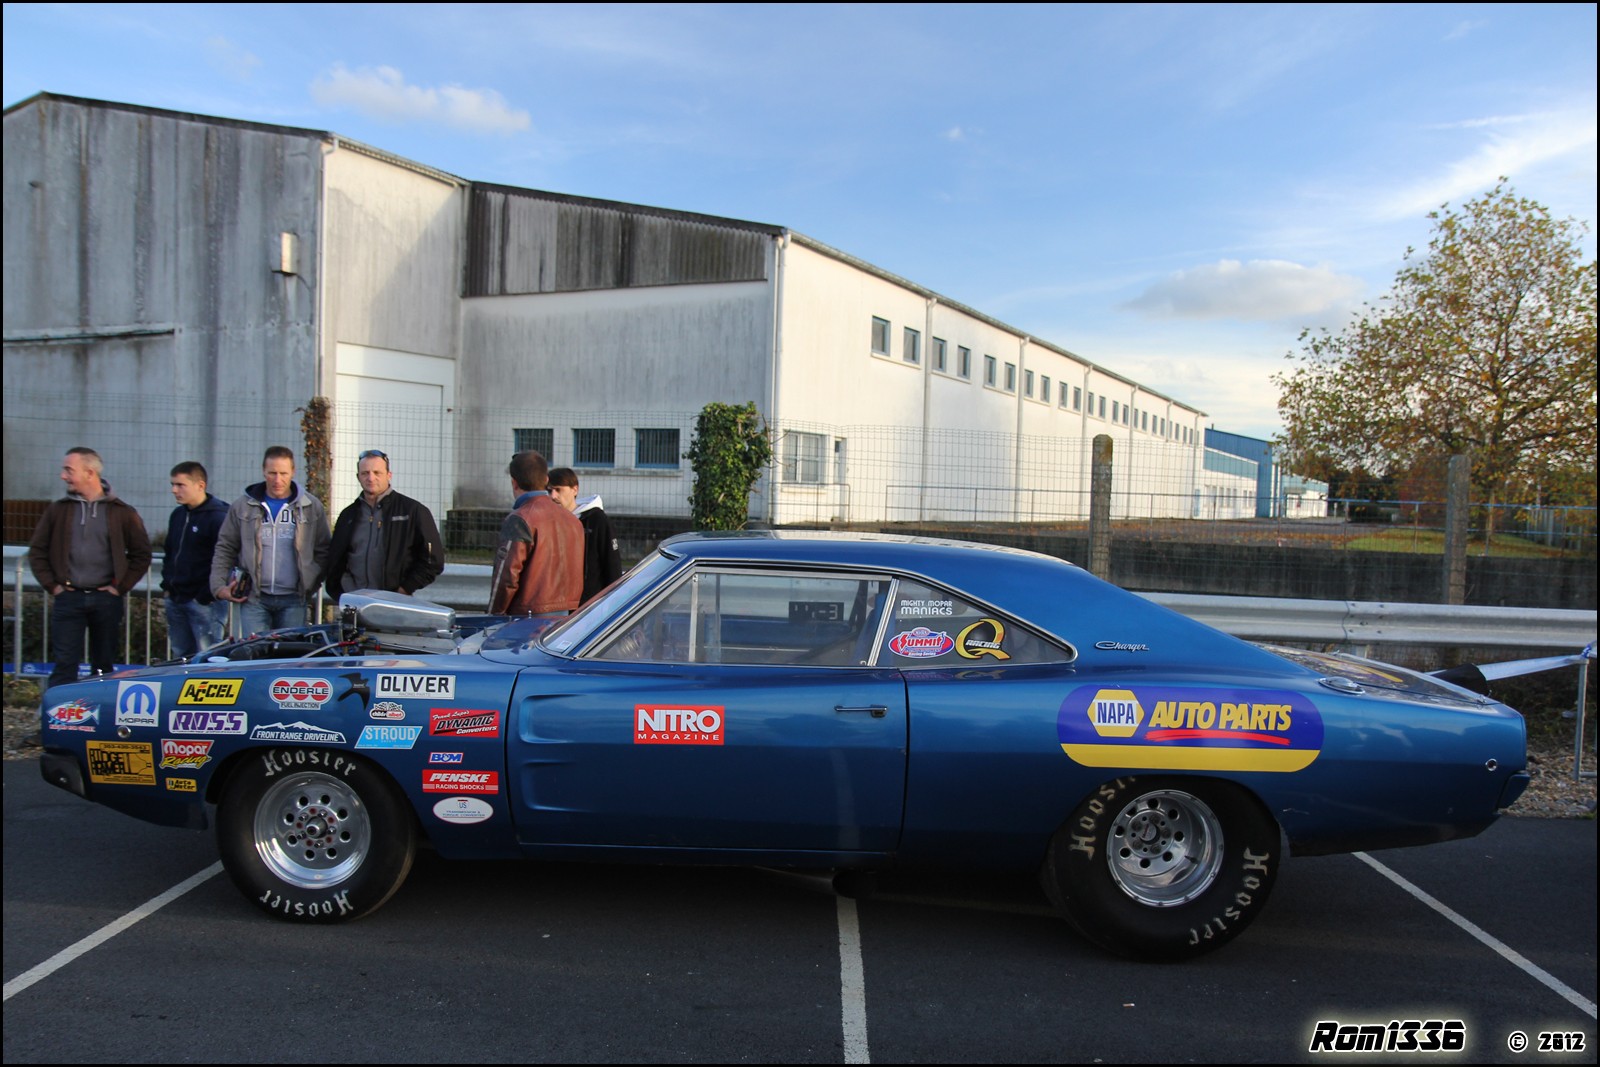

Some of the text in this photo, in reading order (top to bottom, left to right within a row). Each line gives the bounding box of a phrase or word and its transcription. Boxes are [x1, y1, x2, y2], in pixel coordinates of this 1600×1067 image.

[900, 607, 953, 615] MANIACS
[965, 639, 1001, 649] RACING
[1095, 640, 1150, 653] Charger
[272, 686, 329, 695] ENDERLE
[380, 675, 450, 693] OLIVER
[184, 681, 235, 702] ACCEL
[295, 701, 320, 709] INJECTION
[1097, 702, 1135, 724] NAPA
[1148, 701, 1292, 731] AUTO PARTS
[172, 712, 244, 731] ROSS
[435, 715, 495, 731] DYNAMIC
[638, 709, 721, 733] NITRO
[257, 731, 339, 742] FRONT RANGE DRIVELINE
[365, 727, 416, 741] STROUD
[456, 725, 498, 735] Converters
[637, 733, 720, 741] MAGAZINE
[164, 741, 208, 756] Mopar
[160, 755, 208, 769] Racing
[262, 750, 356, 777] Hoosier
[429, 773, 491, 783] PENSKE
[259, 889, 354, 916] Hoosier
[1189, 847, 1270, 945] Hoosier
